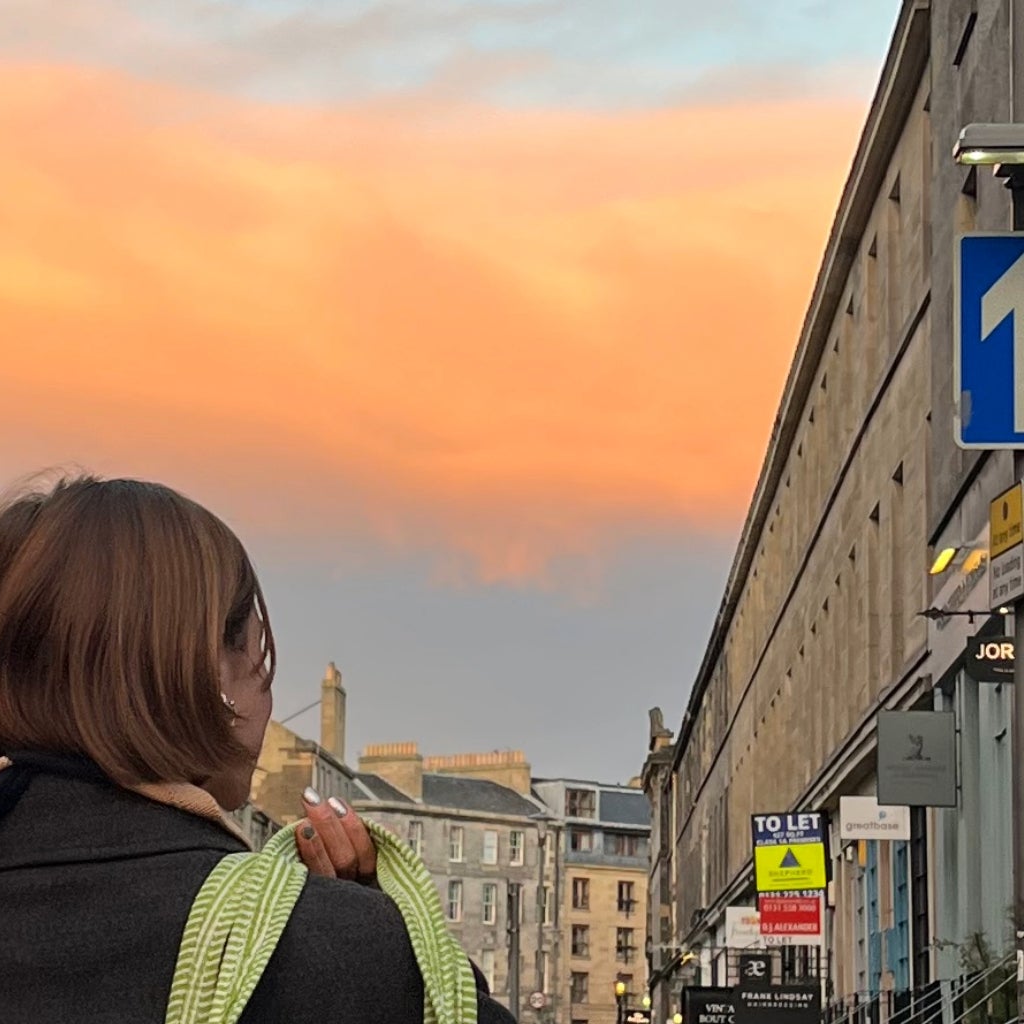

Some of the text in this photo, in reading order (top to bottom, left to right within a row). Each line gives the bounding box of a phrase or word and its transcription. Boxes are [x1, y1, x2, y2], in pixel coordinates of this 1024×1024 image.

[754, 813, 821, 832] TO LET
[845, 821, 899, 832] greatbase
[763, 936, 792, 944] TO LET
[741, 992, 814, 1001] FRANK LINDSAY
